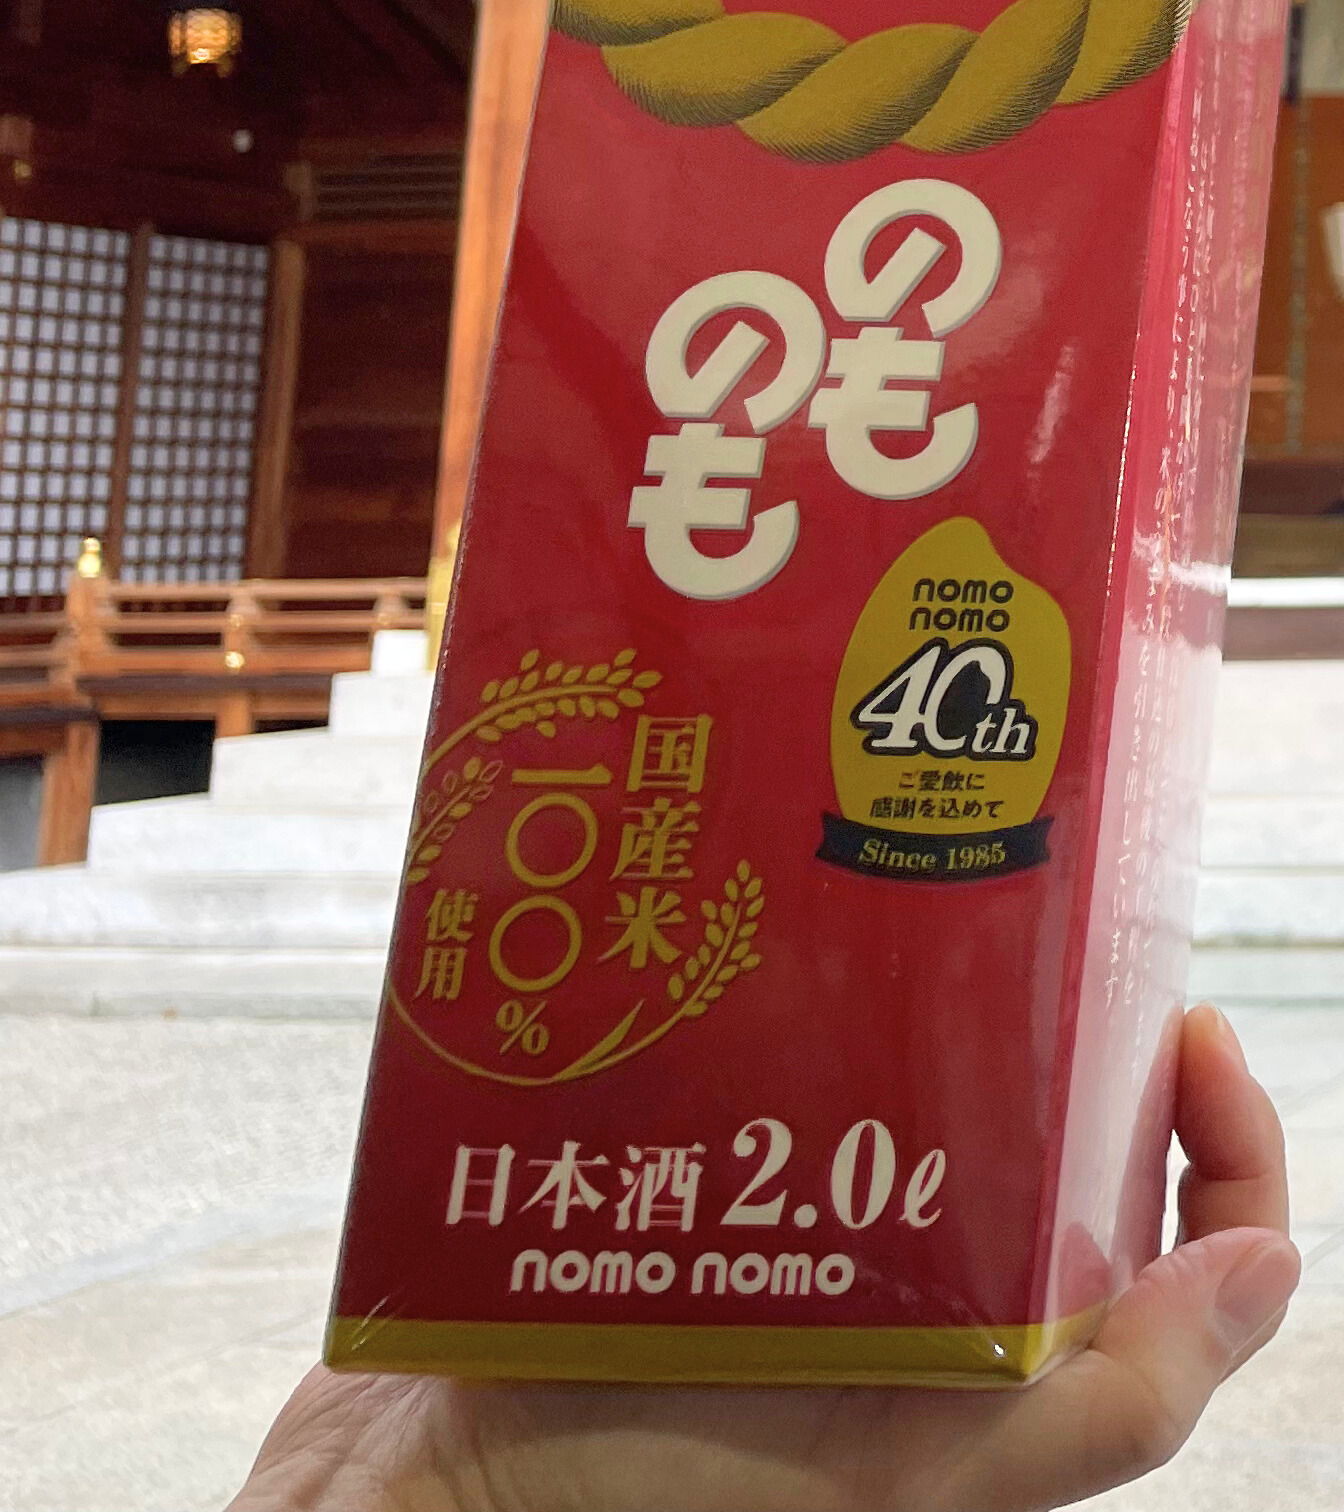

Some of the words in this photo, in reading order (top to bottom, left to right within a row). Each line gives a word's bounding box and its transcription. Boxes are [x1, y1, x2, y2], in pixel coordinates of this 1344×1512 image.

[807, 178, 1002, 501] のも
[626, 270, 826, 601] のも
[908, 606, 1010, 633] nomo
[912, 577, 1014, 604] nomo
[856, 642, 1031, 757] 40th
[869, 796, 1006, 820] 感謝を込めて
[898, 769, 986, 792] ご愛飲に
[602, 715, 715, 971] 国産米
[857, 838, 938, 873] Since
[946, 840, 1007, 873] 1985
[416, 888, 480, 1001] 使用
[444, 1140, 707, 1233] 日本酒
[509, 1248, 676, 1295] nomo
[690, 1252, 856, 1297] nomo
